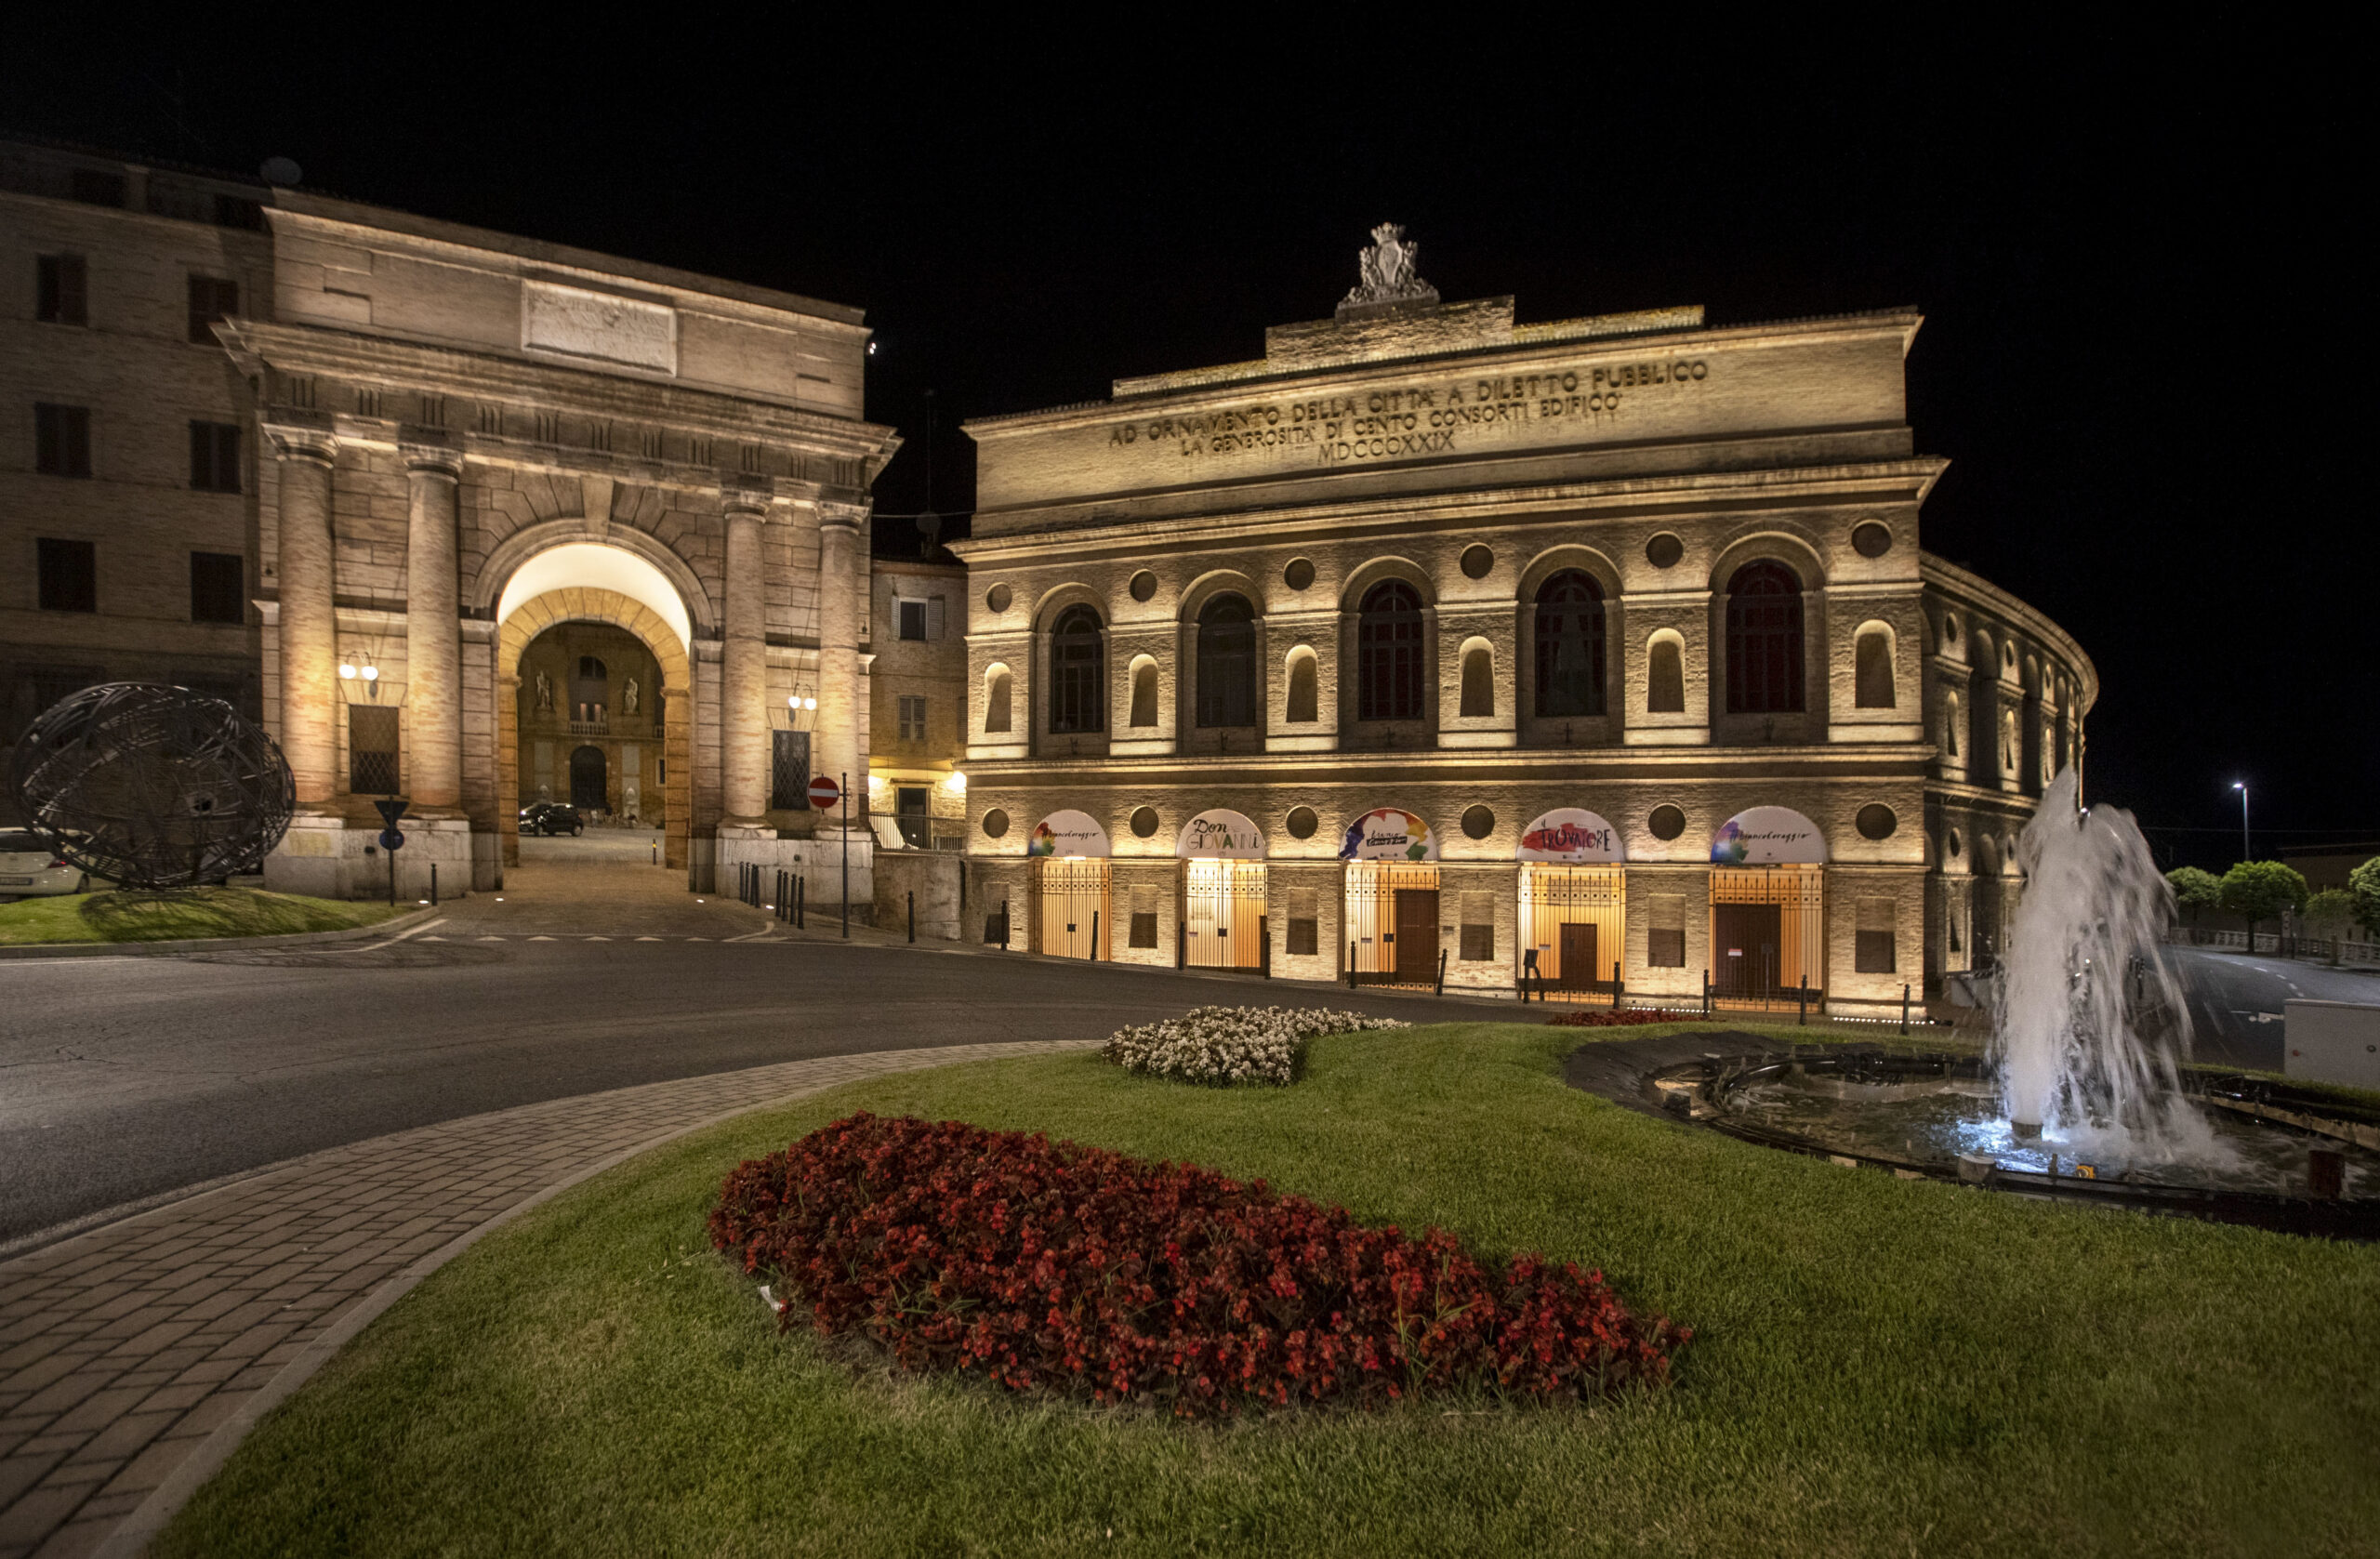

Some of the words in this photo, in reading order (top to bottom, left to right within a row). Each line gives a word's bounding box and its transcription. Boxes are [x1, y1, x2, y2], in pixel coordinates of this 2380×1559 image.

[1109, 424, 1137, 448] AD
[1148, 406, 1279, 441] ORNAMENTO
[1292, 397, 1356, 423] DELLA
[1448, 386, 1463, 405] A
[1477, 371, 1579, 402] DILETTO
[1593, 359, 1708, 390] PUBBLICO
[1182, 439, 1203, 456] LA
[1326, 421, 1343, 440] DI
[1354, 413, 1417, 436] CENTO
[1430, 402, 1528, 428] CONSORTI
[1193, 819, 1227, 834] Don
[1537, 828, 1611, 852] TROVATORE
